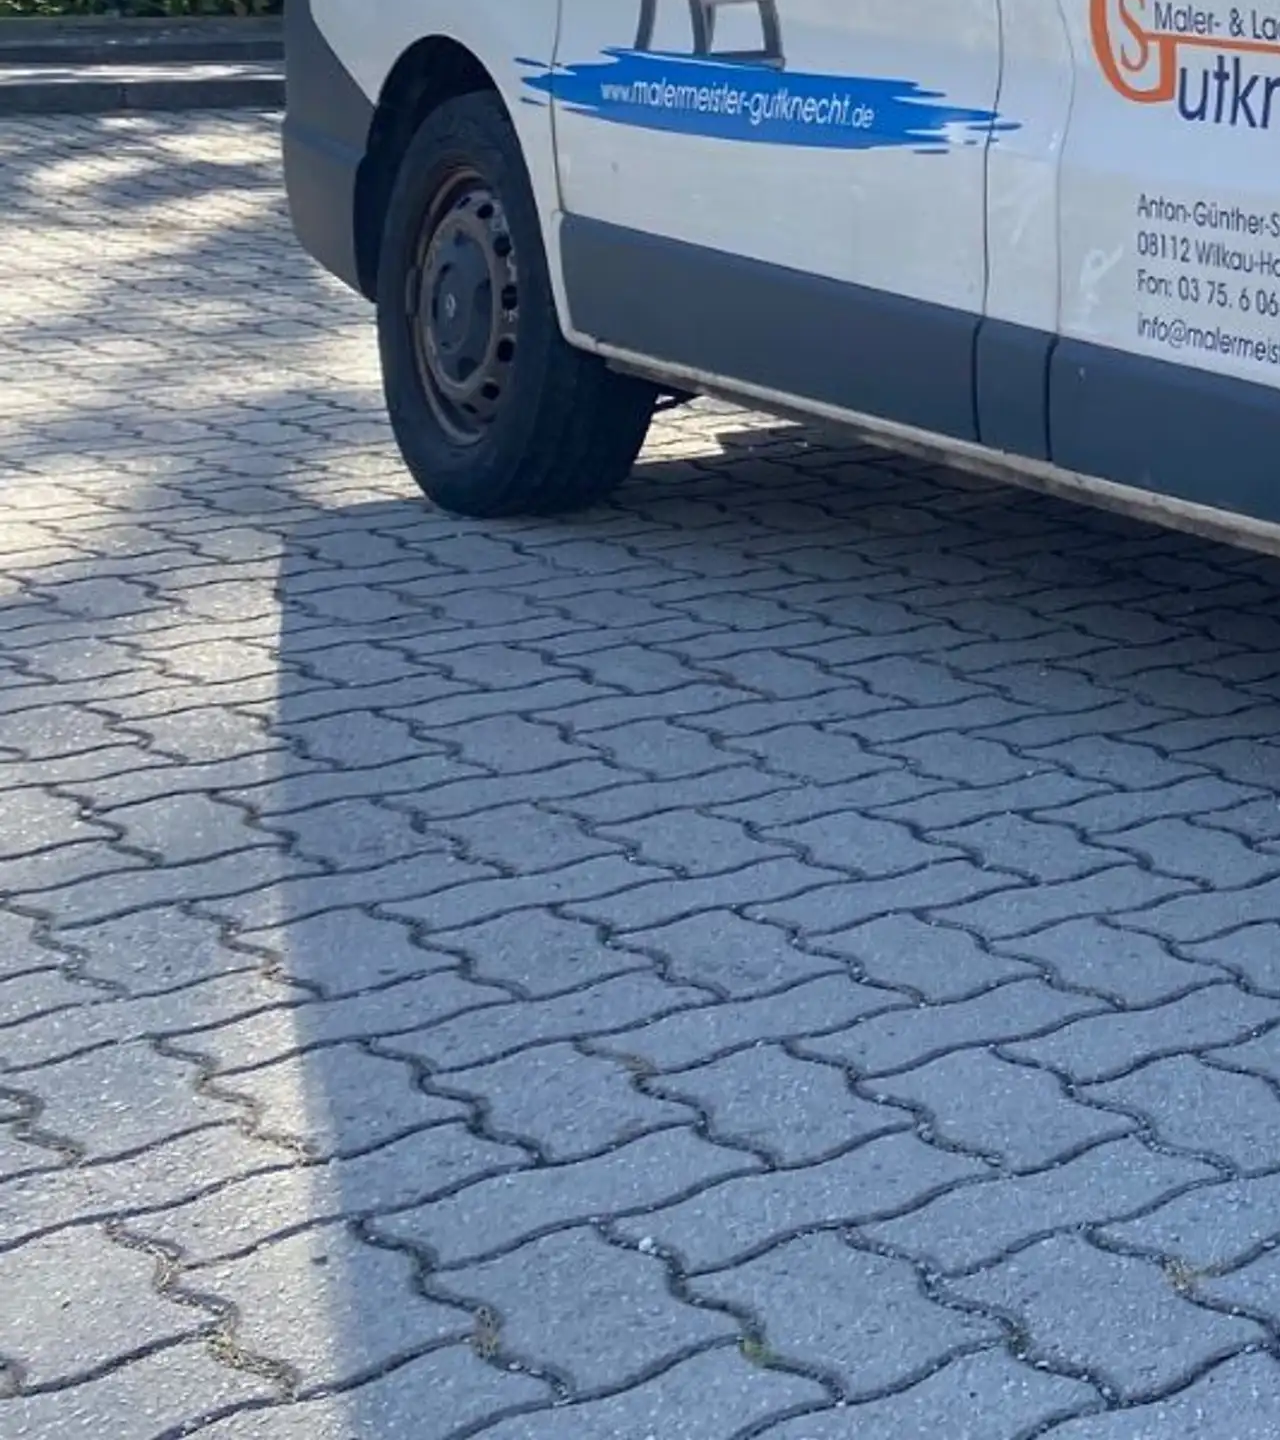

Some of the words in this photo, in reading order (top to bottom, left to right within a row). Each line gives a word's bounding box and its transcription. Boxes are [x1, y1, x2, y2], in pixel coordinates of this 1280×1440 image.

[1153, 0, 1222, 35] Maler-
[1228, 7, 1246, 37] &
[600, 77, 876, 130] www.malermeister-gutknecht.de
[1136, 230, 1191, 264] 08112
[1136, 268, 1173, 298] Fon:
[1178, 275, 1199, 303] 03
[1206, 282, 1233, 309] 75.
[1238, 288, 1251, 312] 6
[1255, 290, 1279, 318] 06
